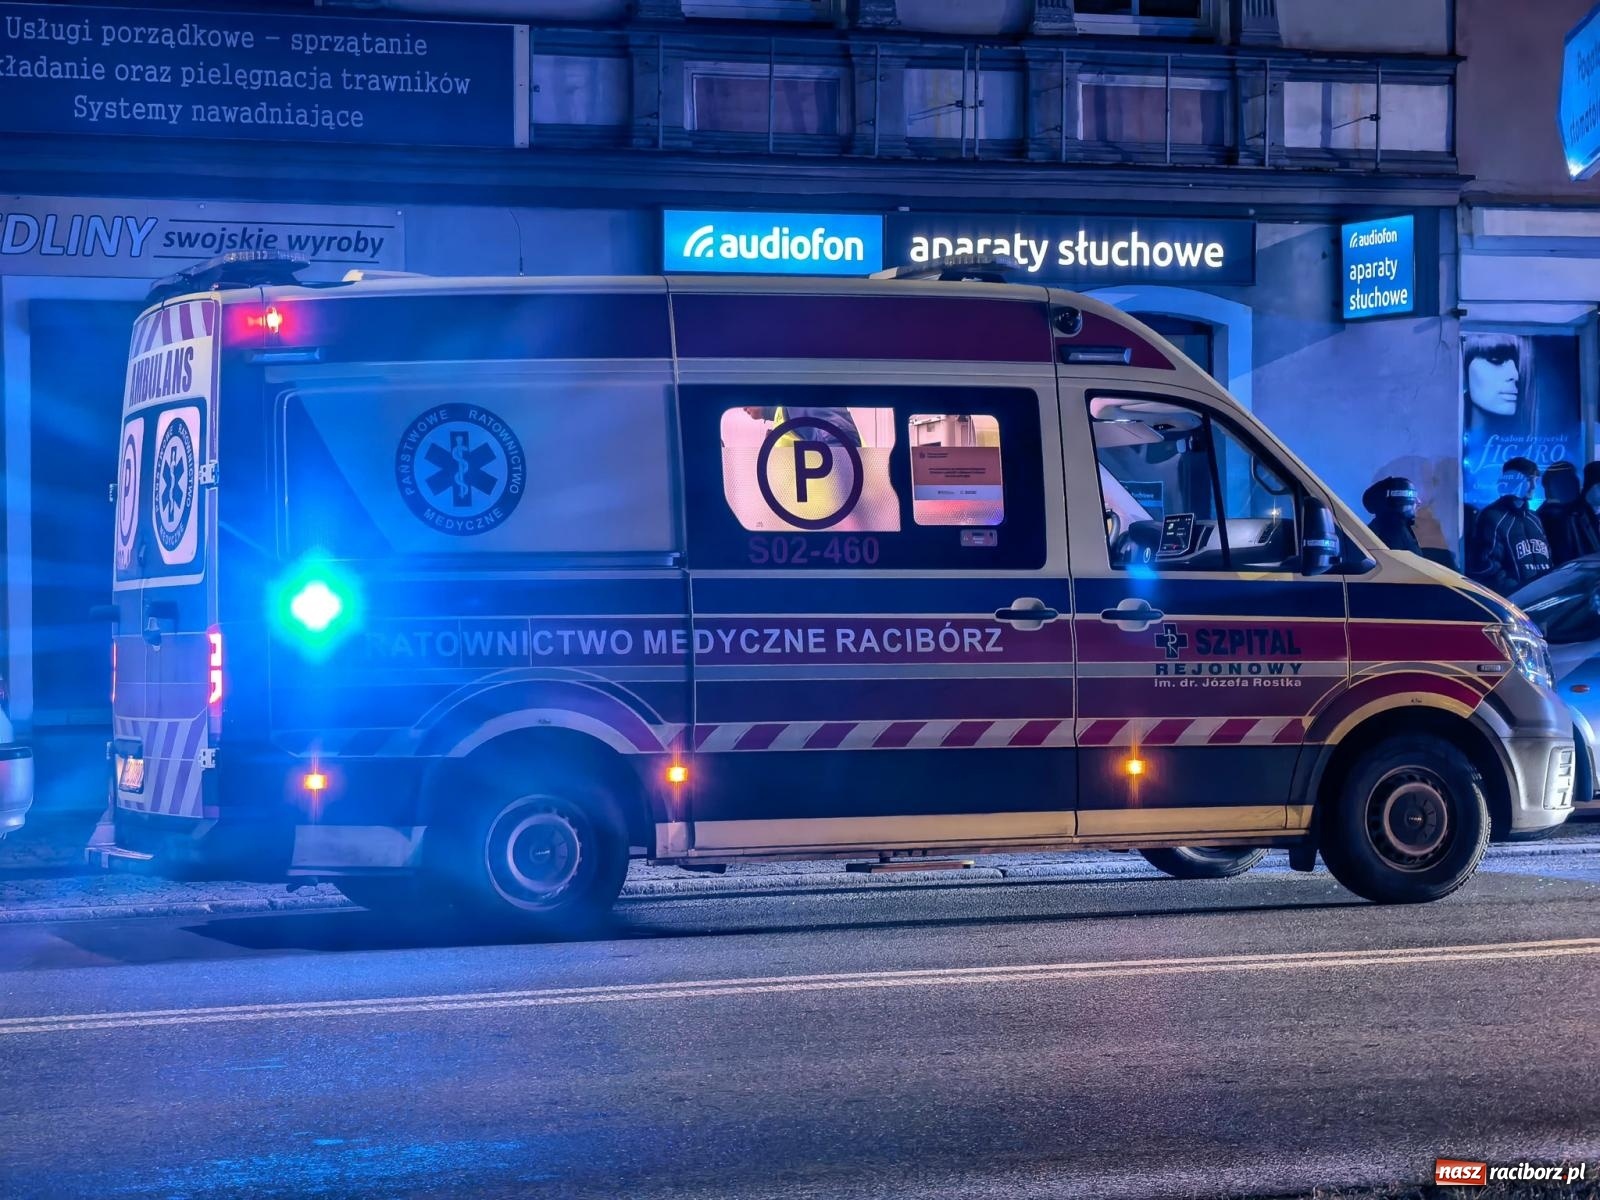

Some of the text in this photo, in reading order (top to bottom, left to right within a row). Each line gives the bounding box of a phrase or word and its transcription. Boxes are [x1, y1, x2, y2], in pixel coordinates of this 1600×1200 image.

[6, 16, 93, 44] Usługi
[101, 24, 254, 48] porządkowe
[291, 32, 427, 56] sprzątanie
[115, 63, 171, 83] oraz
[181, 62, 332, 90] pielęgnacja
[341, 68, 471, 94] trawników
[74, 95, 364, 129] Systemy nawadniające
[0, 212, 385, 258] DLINY swojskie wyroby
[720, 226, 863, 261] audiofon
[1058, 230, 1225, 269] słuchowe
[1358, 228, 1398, 247] audiofon
[1349, 257, 1398, 284] aparaty
[1349, 287, 1408, 310] słuchowe
[129, 346, 194, 408] AMBULANS
[468, 409, 522, 494] RATOWNICTWO
[793, 440, 833, 502] P
[423, 507, 503, 531] MEDYCZNE
[750, 535, 880, 565] S02-460
[644, 628, 826, 654] MEDYCZNE
[837, 622, 1003, 652] RACIBÓRZ
[1195, 628, 1303, 656] SZPITAL
[1155, 662, 1303, 675] REJONOWY
[1180, 678, 1198, 687] dr.
[1202, 677, 1249, 688] Józefa
[1253, 678, 1302, 687] Rostka
